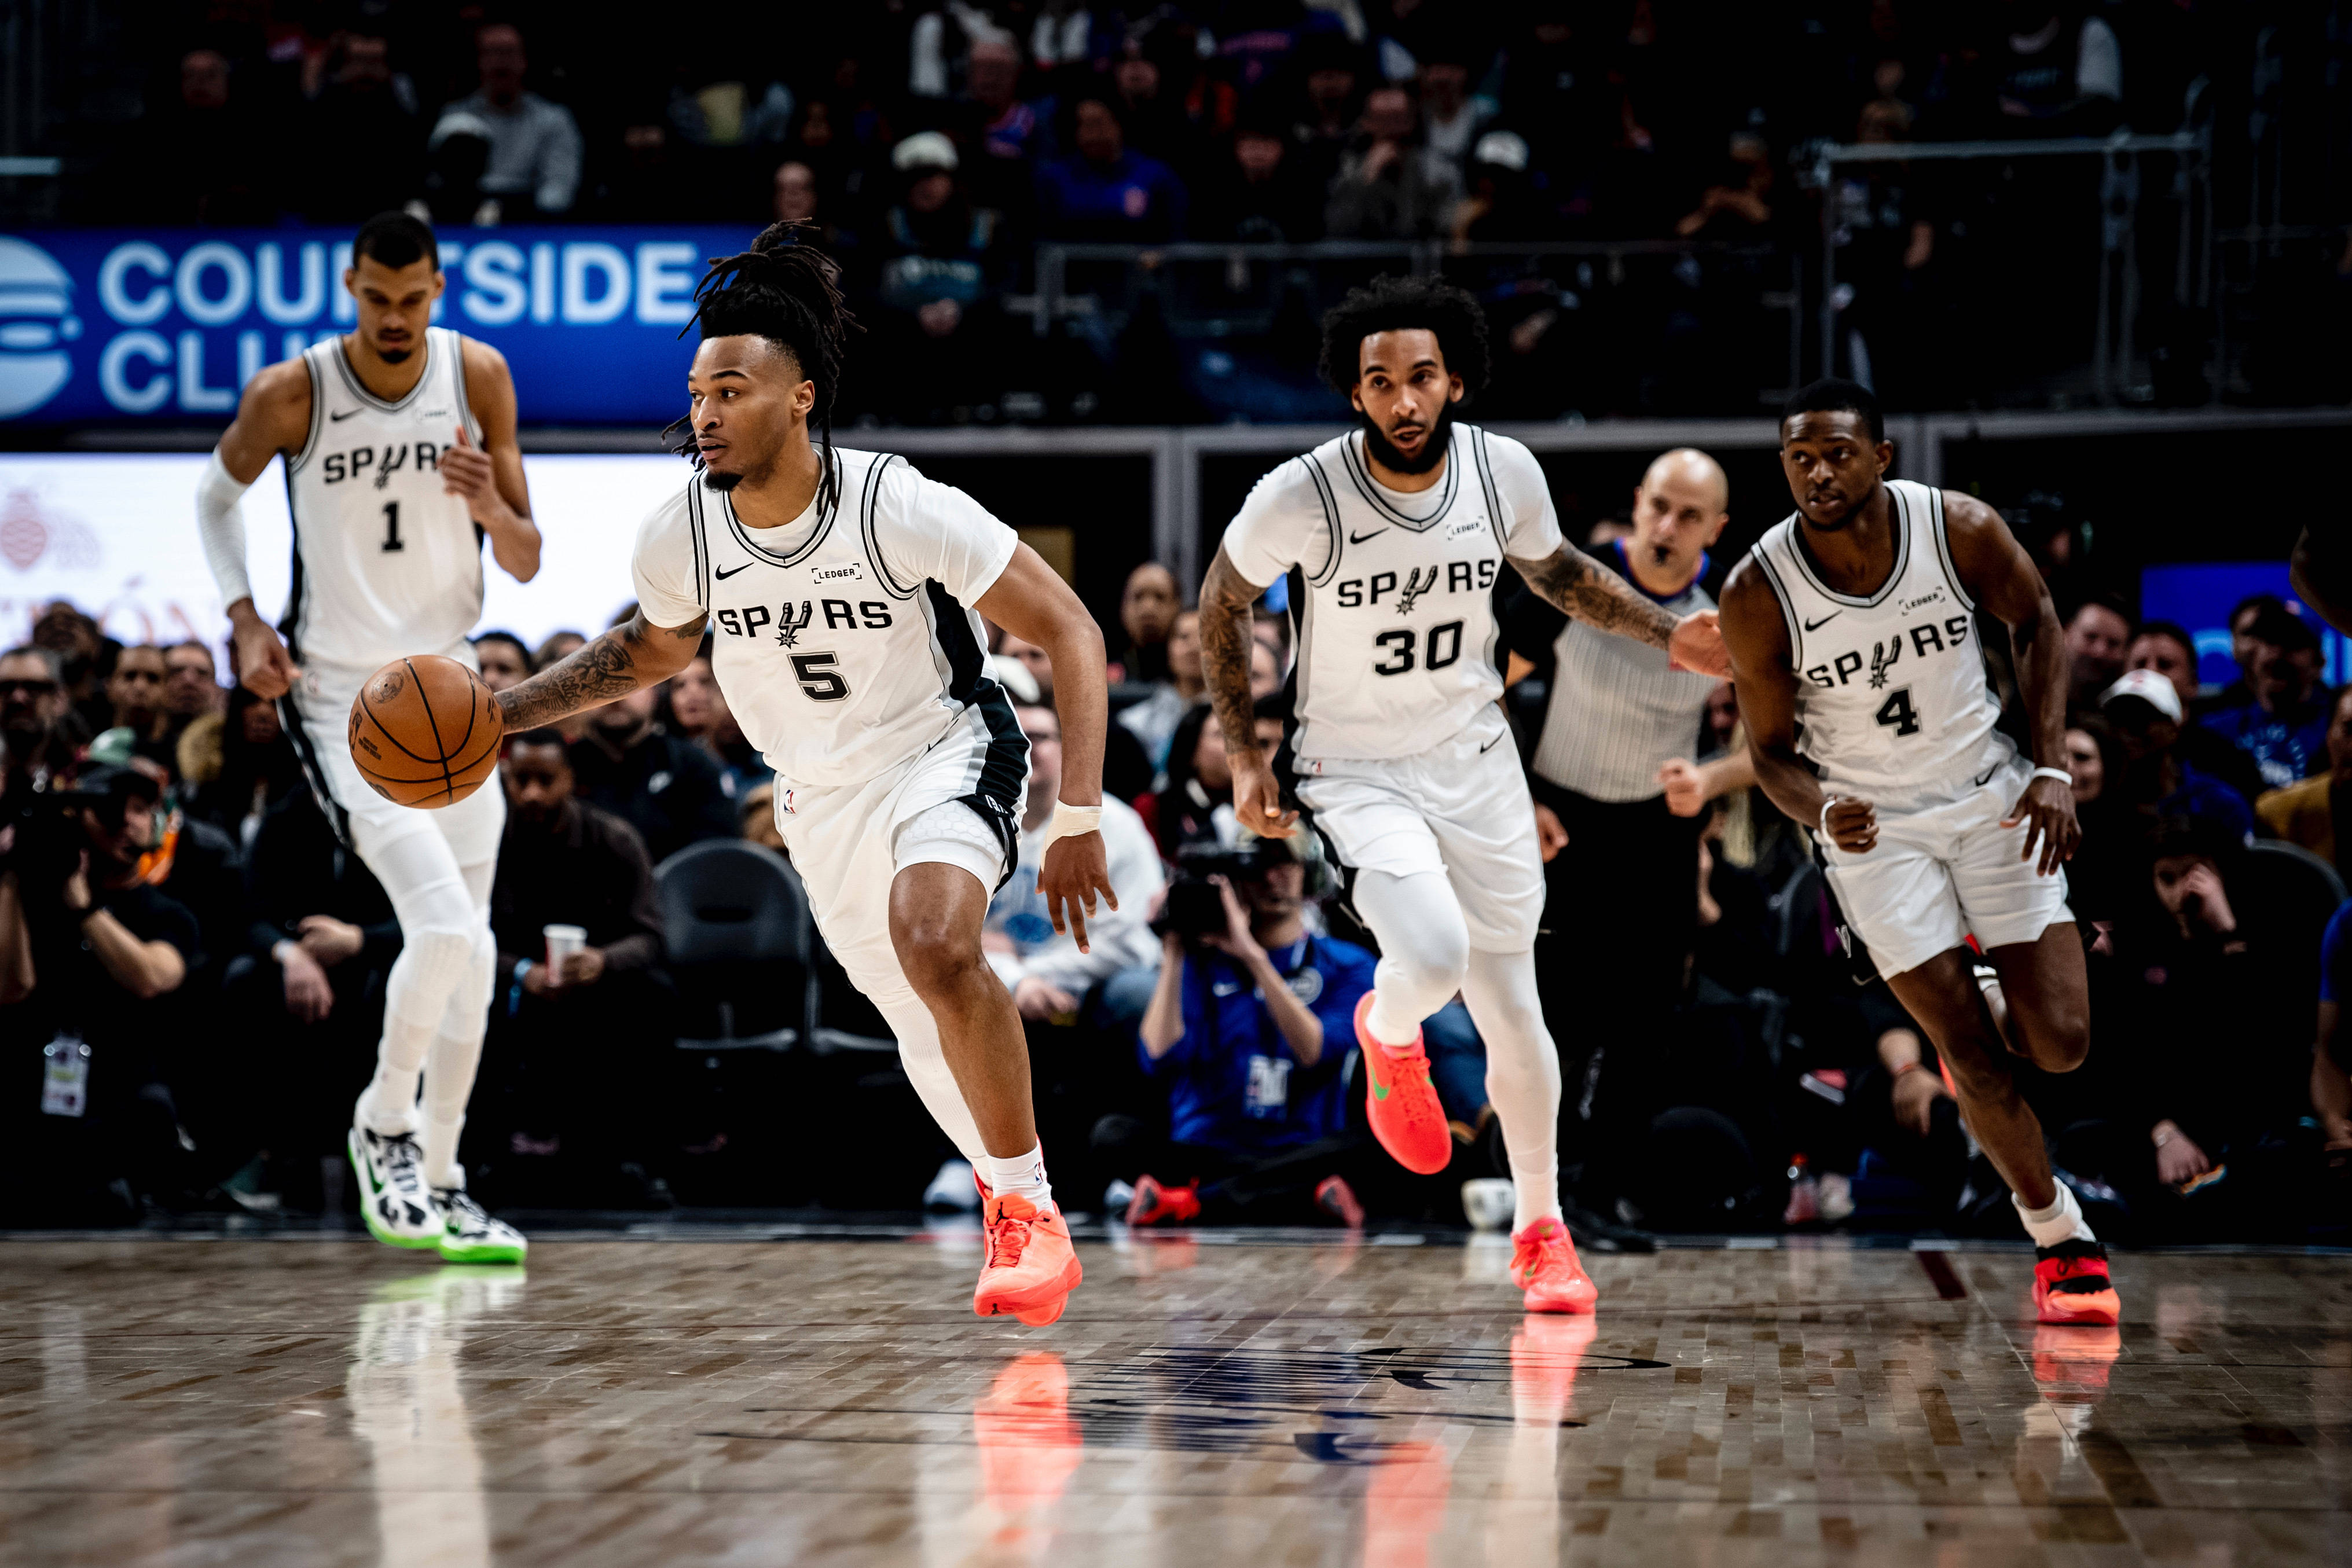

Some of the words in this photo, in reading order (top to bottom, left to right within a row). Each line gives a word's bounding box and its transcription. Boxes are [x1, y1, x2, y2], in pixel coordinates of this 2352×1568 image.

[323, 441, 453, 491] SPUR
[381, 500, 405, 552] 1
[819, 568, 855, 579] LEDGER
[1337, 559, 1495, 615] SPURS
[718, 599, 893, 649] SPURS
[1373, 617, 1466, 676] 30
[787, 651, 852, 702] 5
[1807, 615, 1968, 691] SPURS
[1873, 684, 1922, 739] 4
